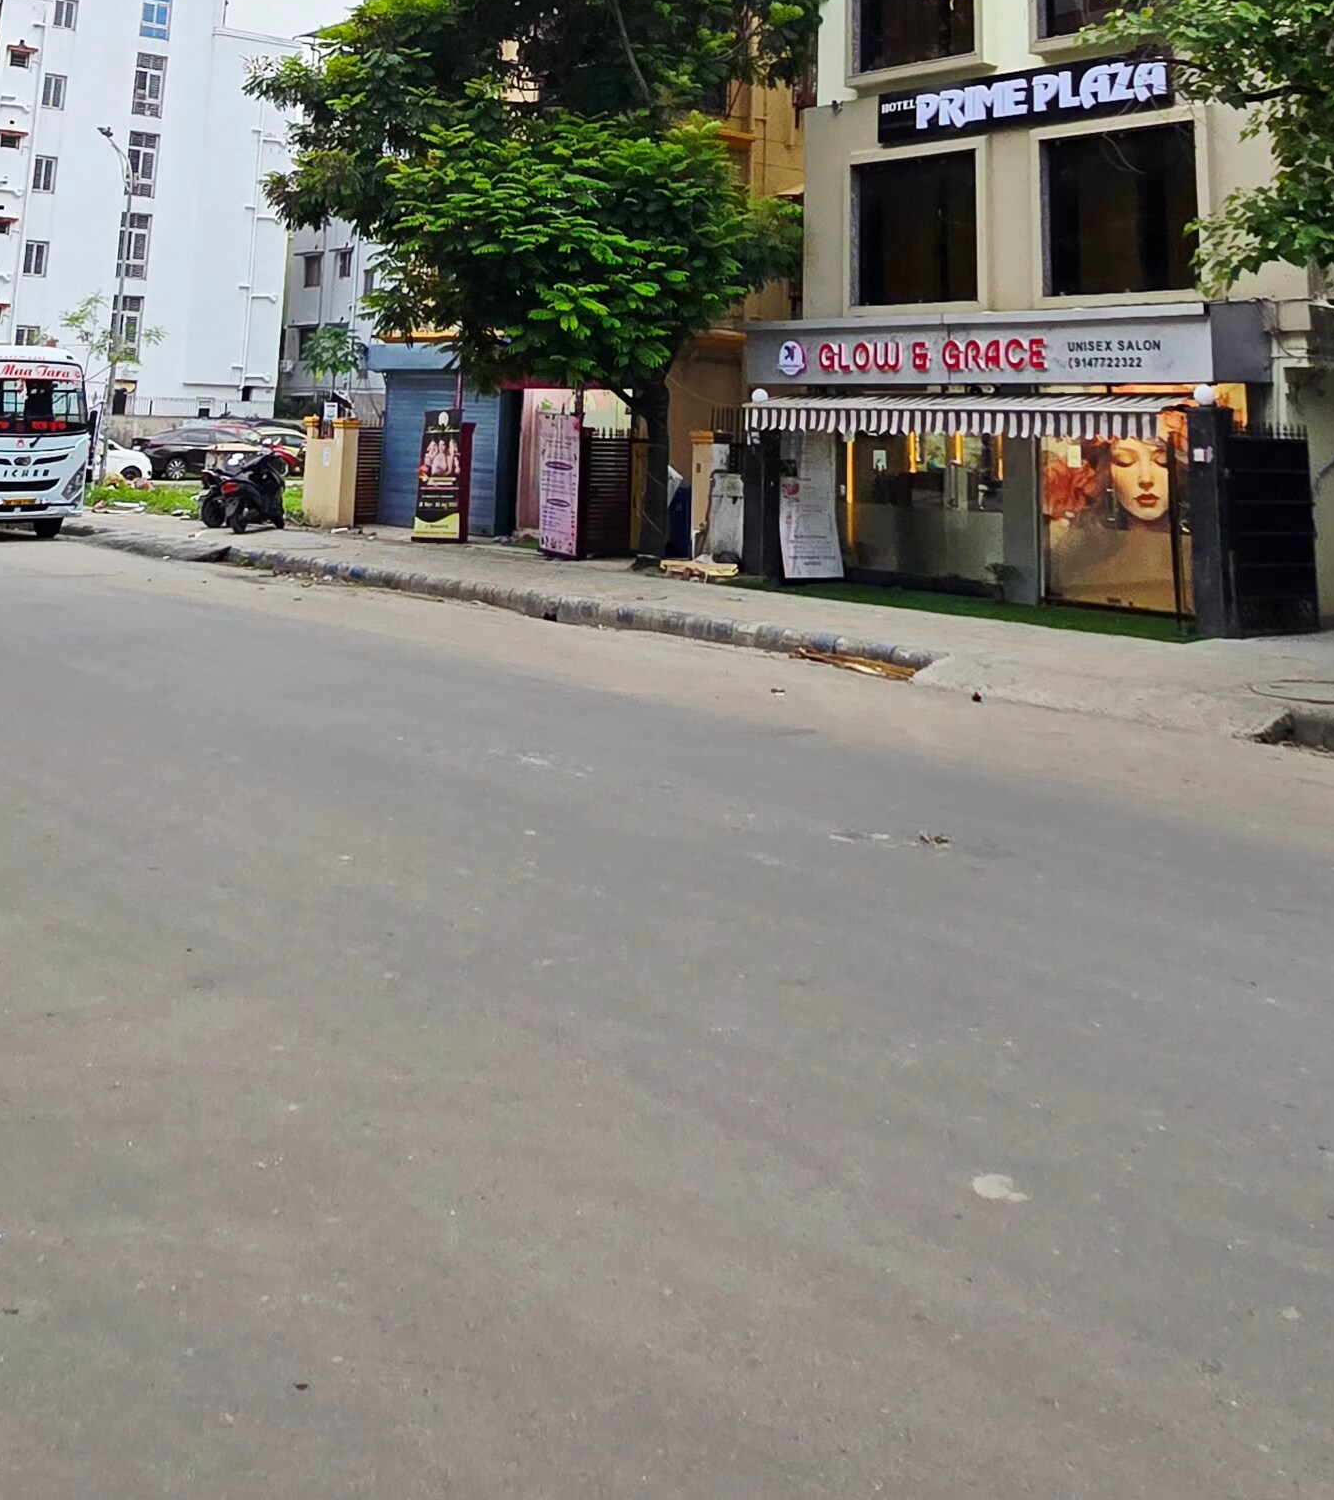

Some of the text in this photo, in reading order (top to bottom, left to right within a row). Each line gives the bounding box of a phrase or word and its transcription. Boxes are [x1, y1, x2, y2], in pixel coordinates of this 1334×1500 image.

[881, 62, 1167, 129] HOTEL PRIME PLAZA
[818, 337, 1047, 373] GLOW & GRACE
[1067, 339, 1162, 352] UNISEX SALON
[36, 365, 70, 378] Tara
